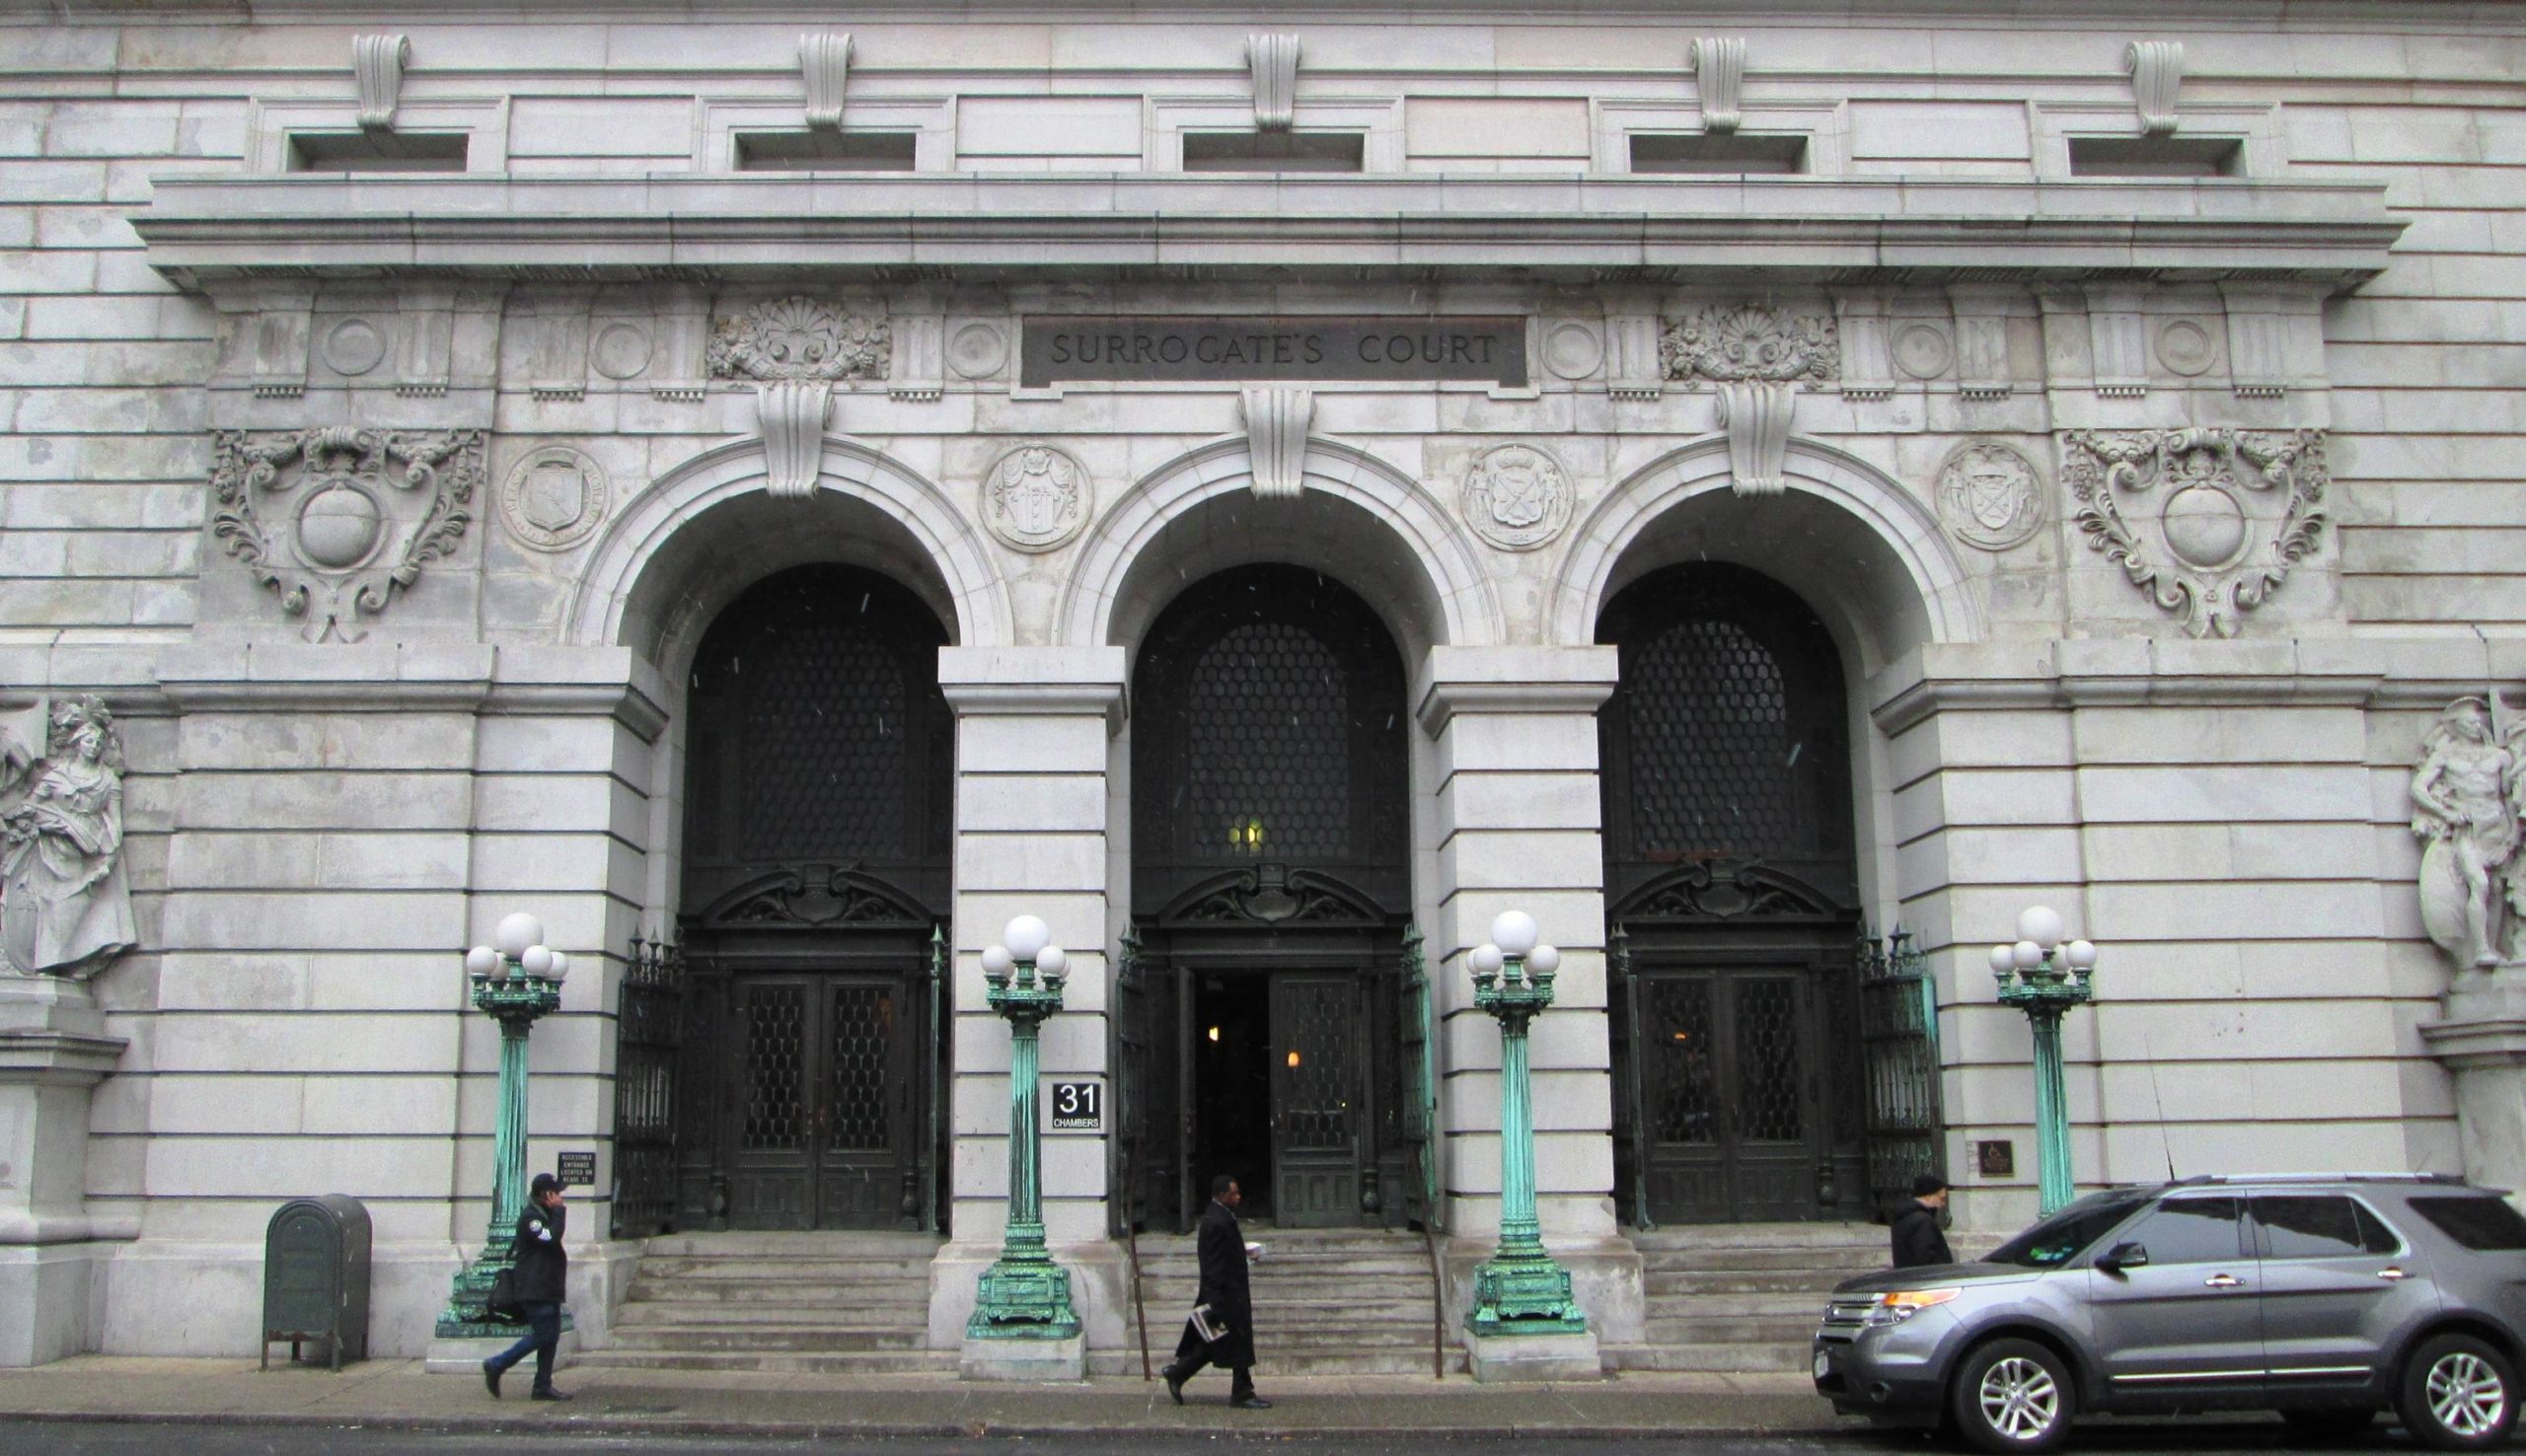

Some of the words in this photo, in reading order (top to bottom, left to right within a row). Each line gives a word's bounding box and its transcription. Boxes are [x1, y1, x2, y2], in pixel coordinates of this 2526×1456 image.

[1052, 333, 1323, 364] SURROGATE'S
[1358, 333, 1498, 364] COURT
[1059, 1085, 1093, 1113] 31
[1054, 1119, 1098, 1128] CHAMBERS
